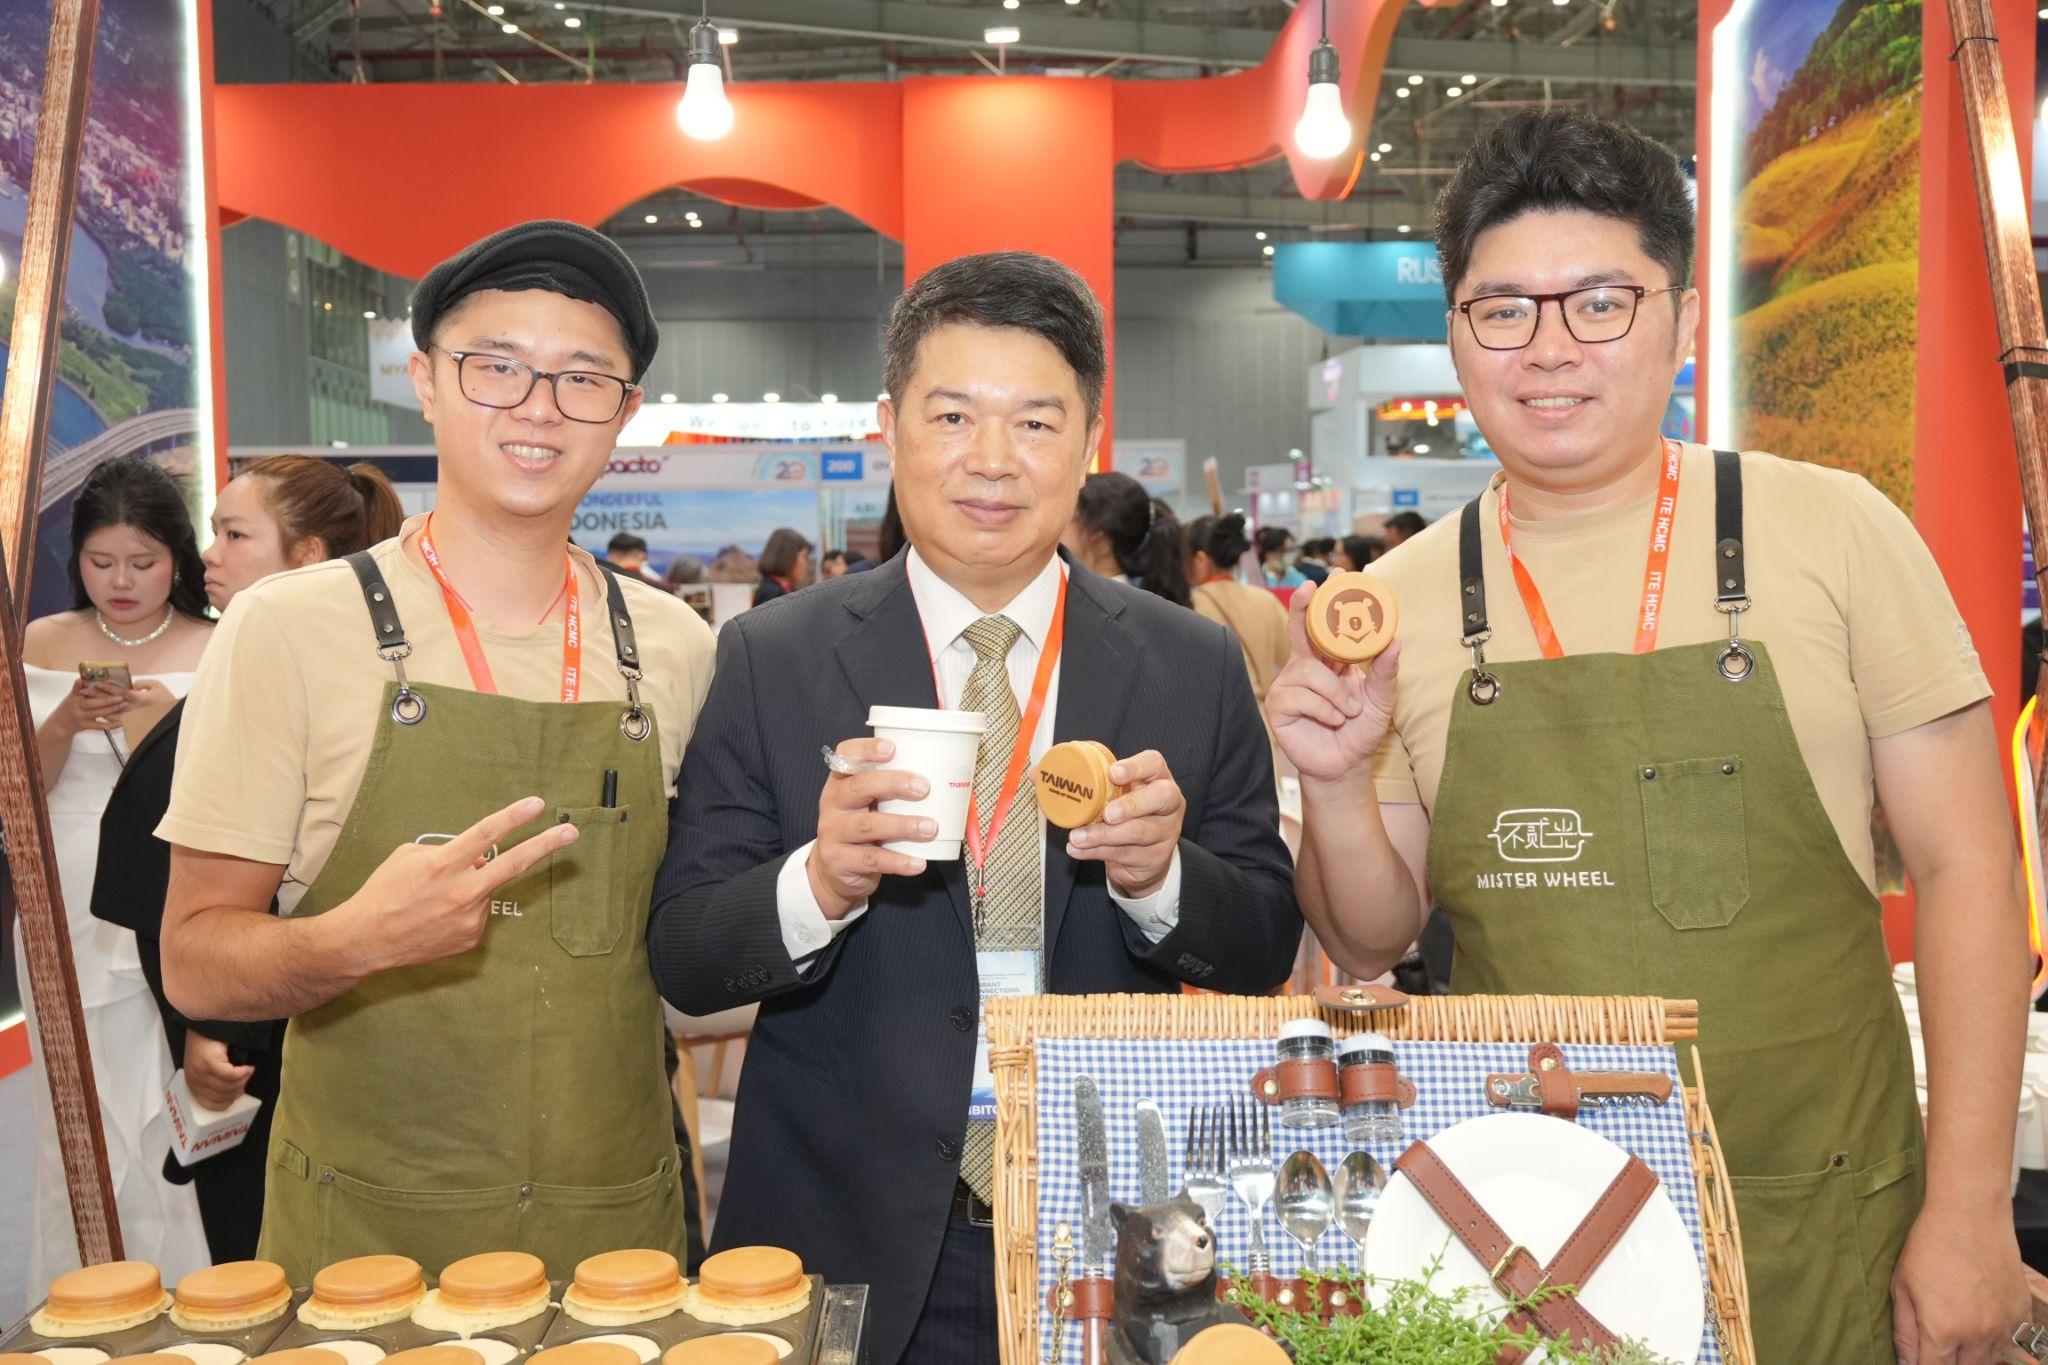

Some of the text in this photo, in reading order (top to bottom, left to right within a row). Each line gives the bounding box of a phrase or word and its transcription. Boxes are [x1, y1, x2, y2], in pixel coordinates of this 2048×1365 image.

[1653, 497, 1674, 552] ITE HCMC
[1642, 571, 1662, 631] ITE HCMC
[567, 615, 578, 649] HCMC
[565, 667, 577, 686] ITE
[1040, 770, 1094, 801] TAIWAN
[1477, 871, 1614, 889] MISTER WHEEL
